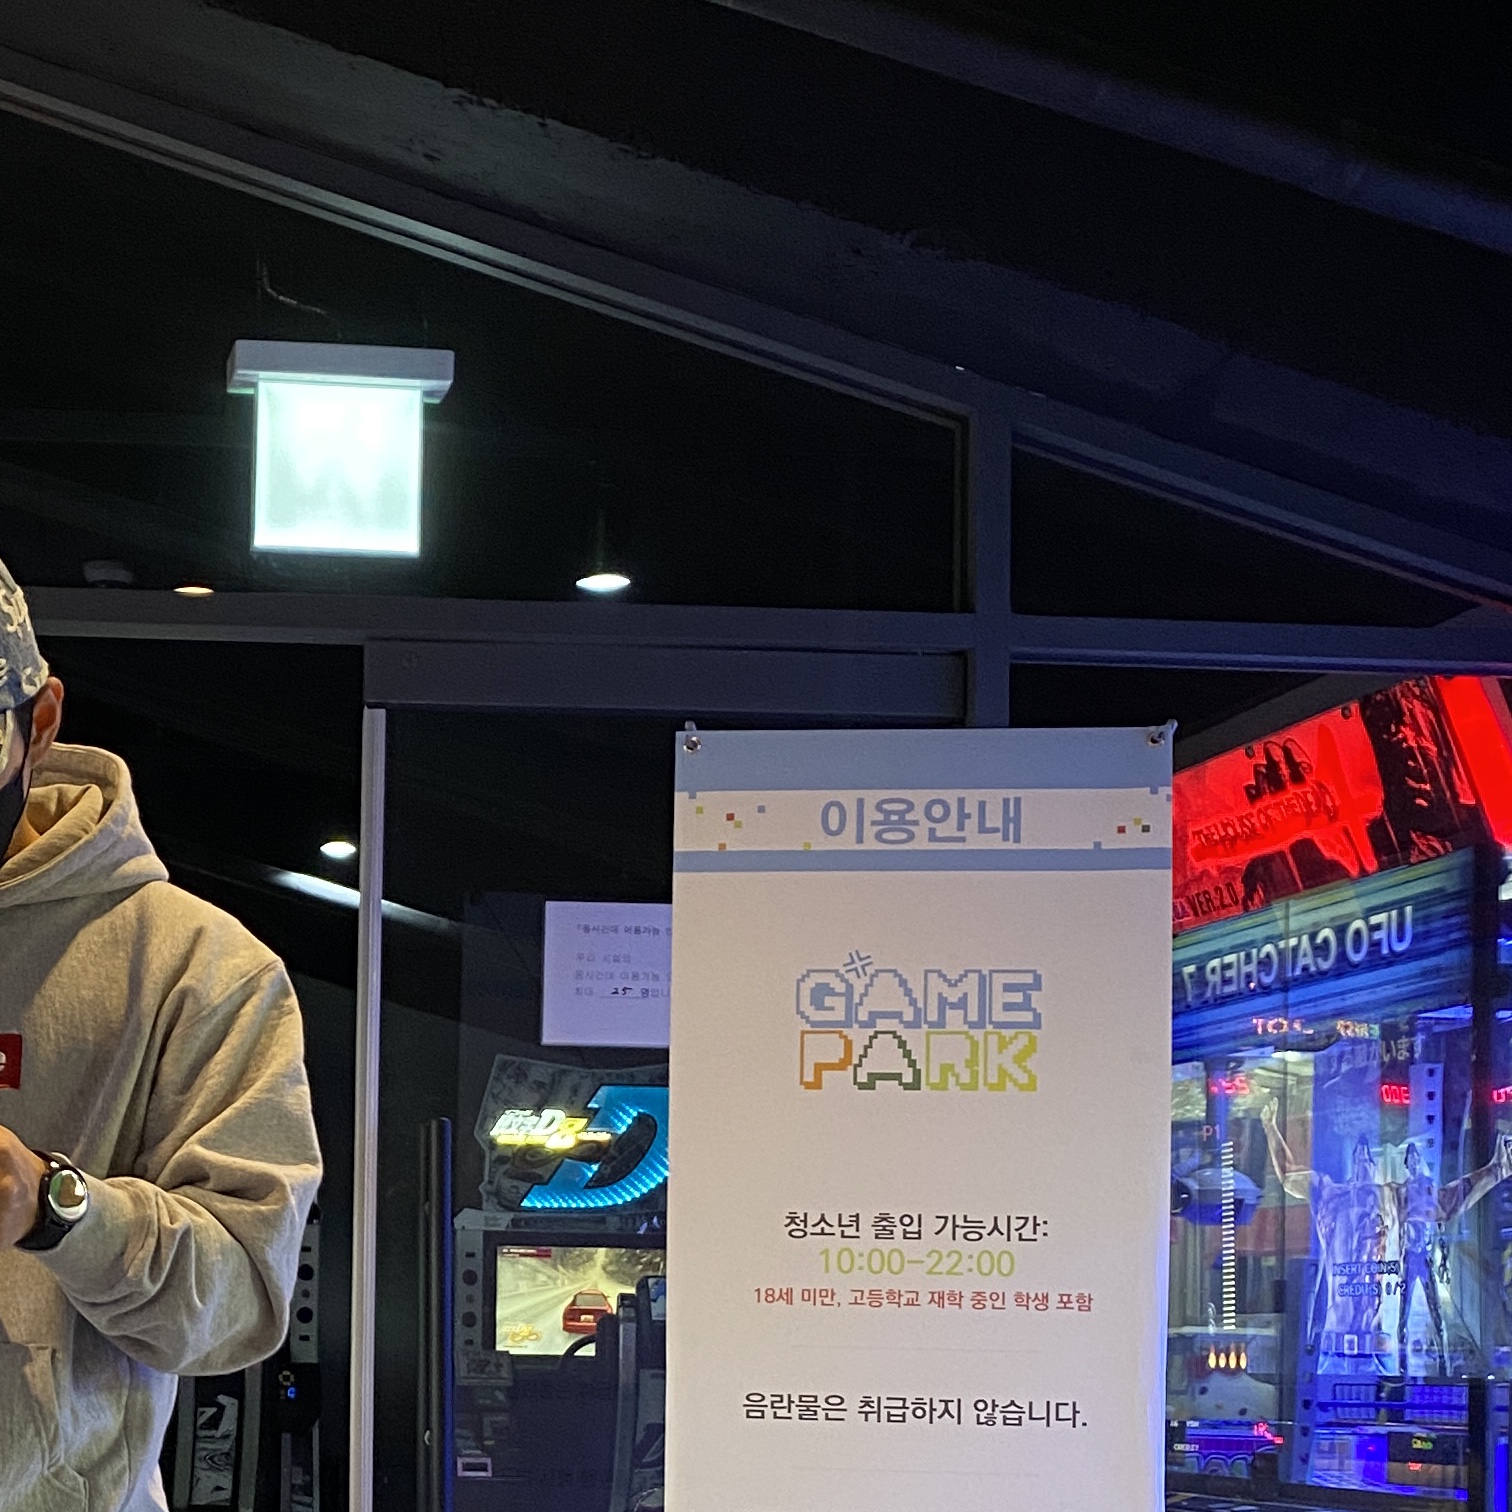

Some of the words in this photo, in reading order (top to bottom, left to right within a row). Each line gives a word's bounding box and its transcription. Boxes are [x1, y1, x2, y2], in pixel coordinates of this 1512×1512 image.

[821, 797, 1021, 844] 이용안내
[796, 967, 1042, 1031] GAME
[799, 1029, 1041, 1092] PARK
[784, 1212, 860, 1239] 청소년
[871, 1213, 922, 1240] 출입
[934, 1214, 1048, 1242] 가능시간:
[820, 1247, 1015, 1277] 10:00-22:00
[754, 1287, 793, 1305] 18세
[801, 1288, 840, 1307] 미만,
[848, 1289, 921, 1308] 고등학교
[927, 1290, 964, 1309] 재학
[970, 1291, 1006, 1310] 중인
[1014, 1292, 1049, 1311] 학생
[1056, 1293, 1093, 1312] 포함
[742, 1393, 848, 1422] 음란물은
[857, 1395, 961, 1425] 취급하지
[973, 1398, 1087, 1428] 않습니다.
